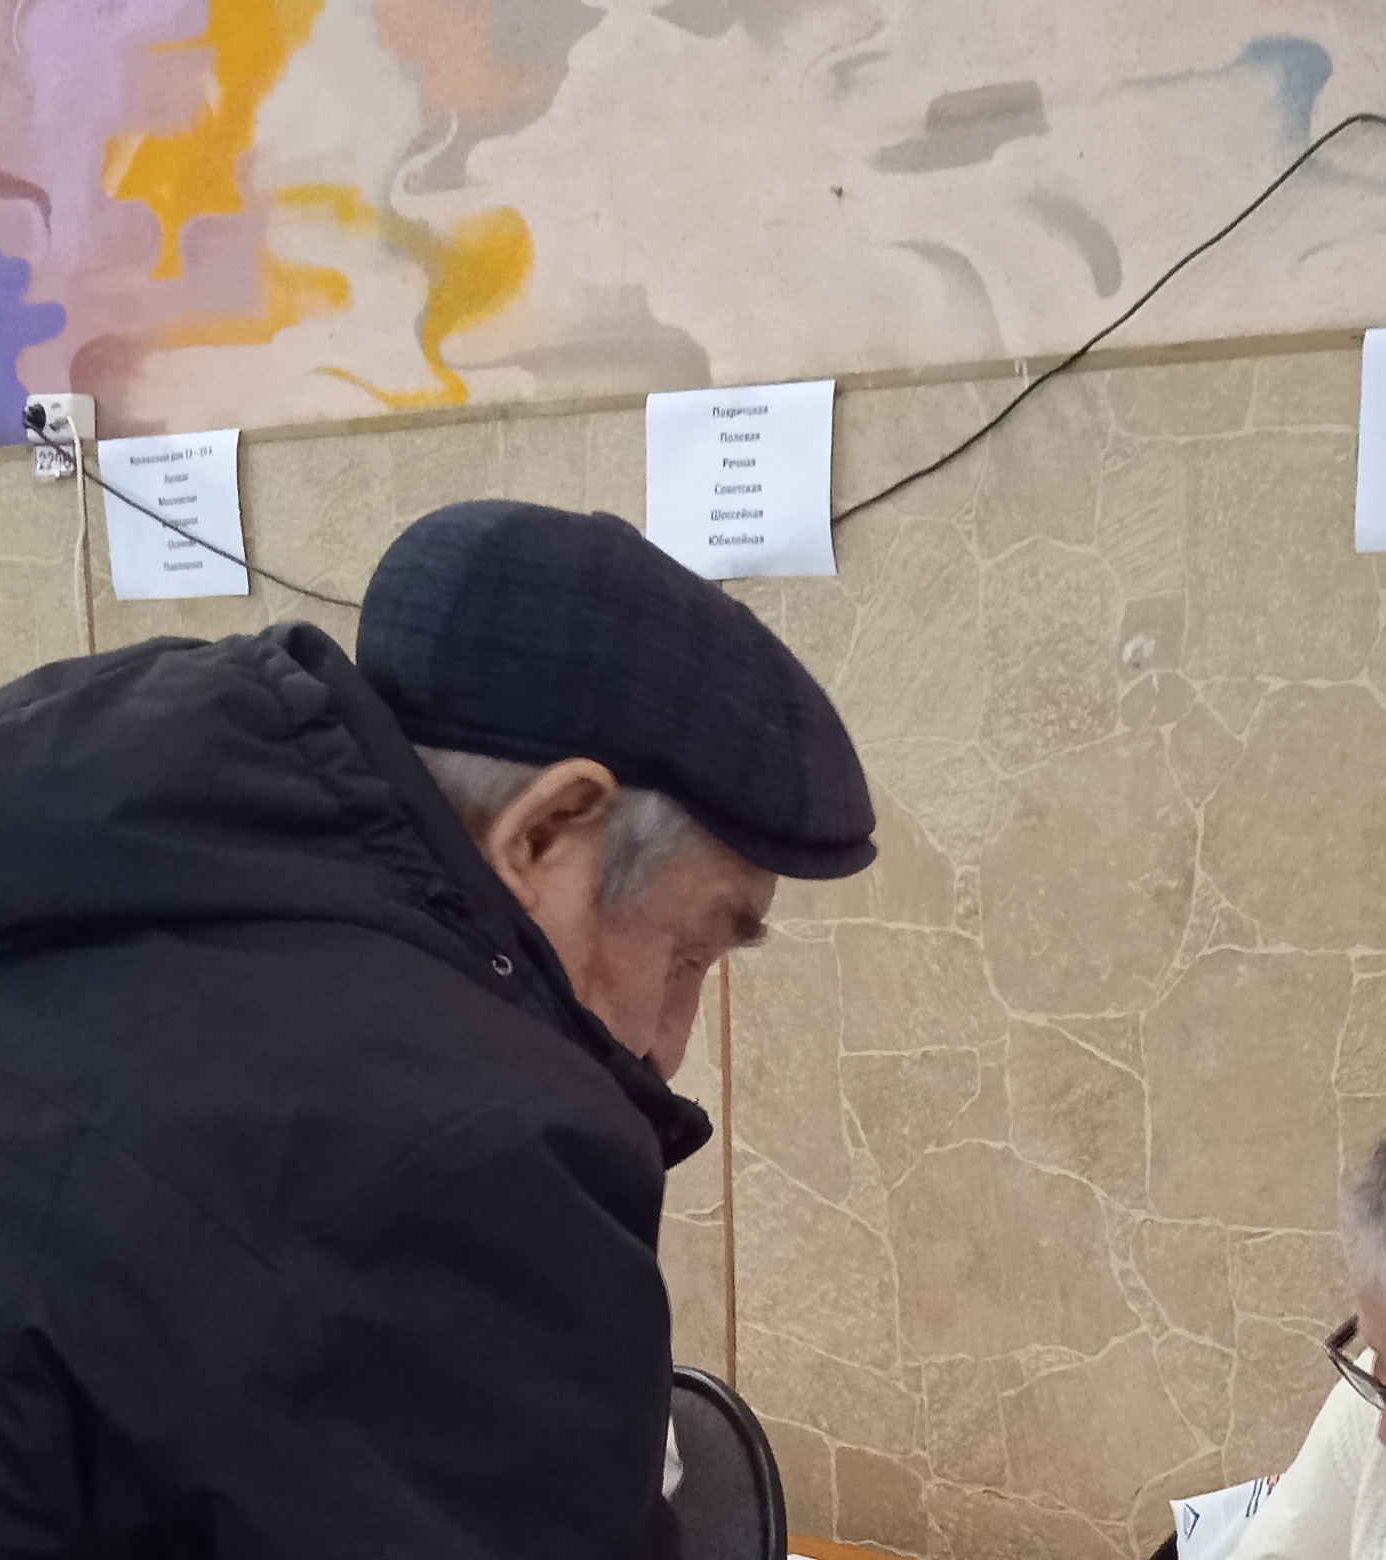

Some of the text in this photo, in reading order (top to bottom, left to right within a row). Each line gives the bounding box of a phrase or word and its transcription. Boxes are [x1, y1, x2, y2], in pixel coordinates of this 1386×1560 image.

[720, 431, 760, 444] Полевая
[722, 457, 756, 469] Речная
[714, 482, 763, 495] Советская
[711, 508, 764, 521] Шоссейная
[709, 533, 765, 547] Юбилейная
